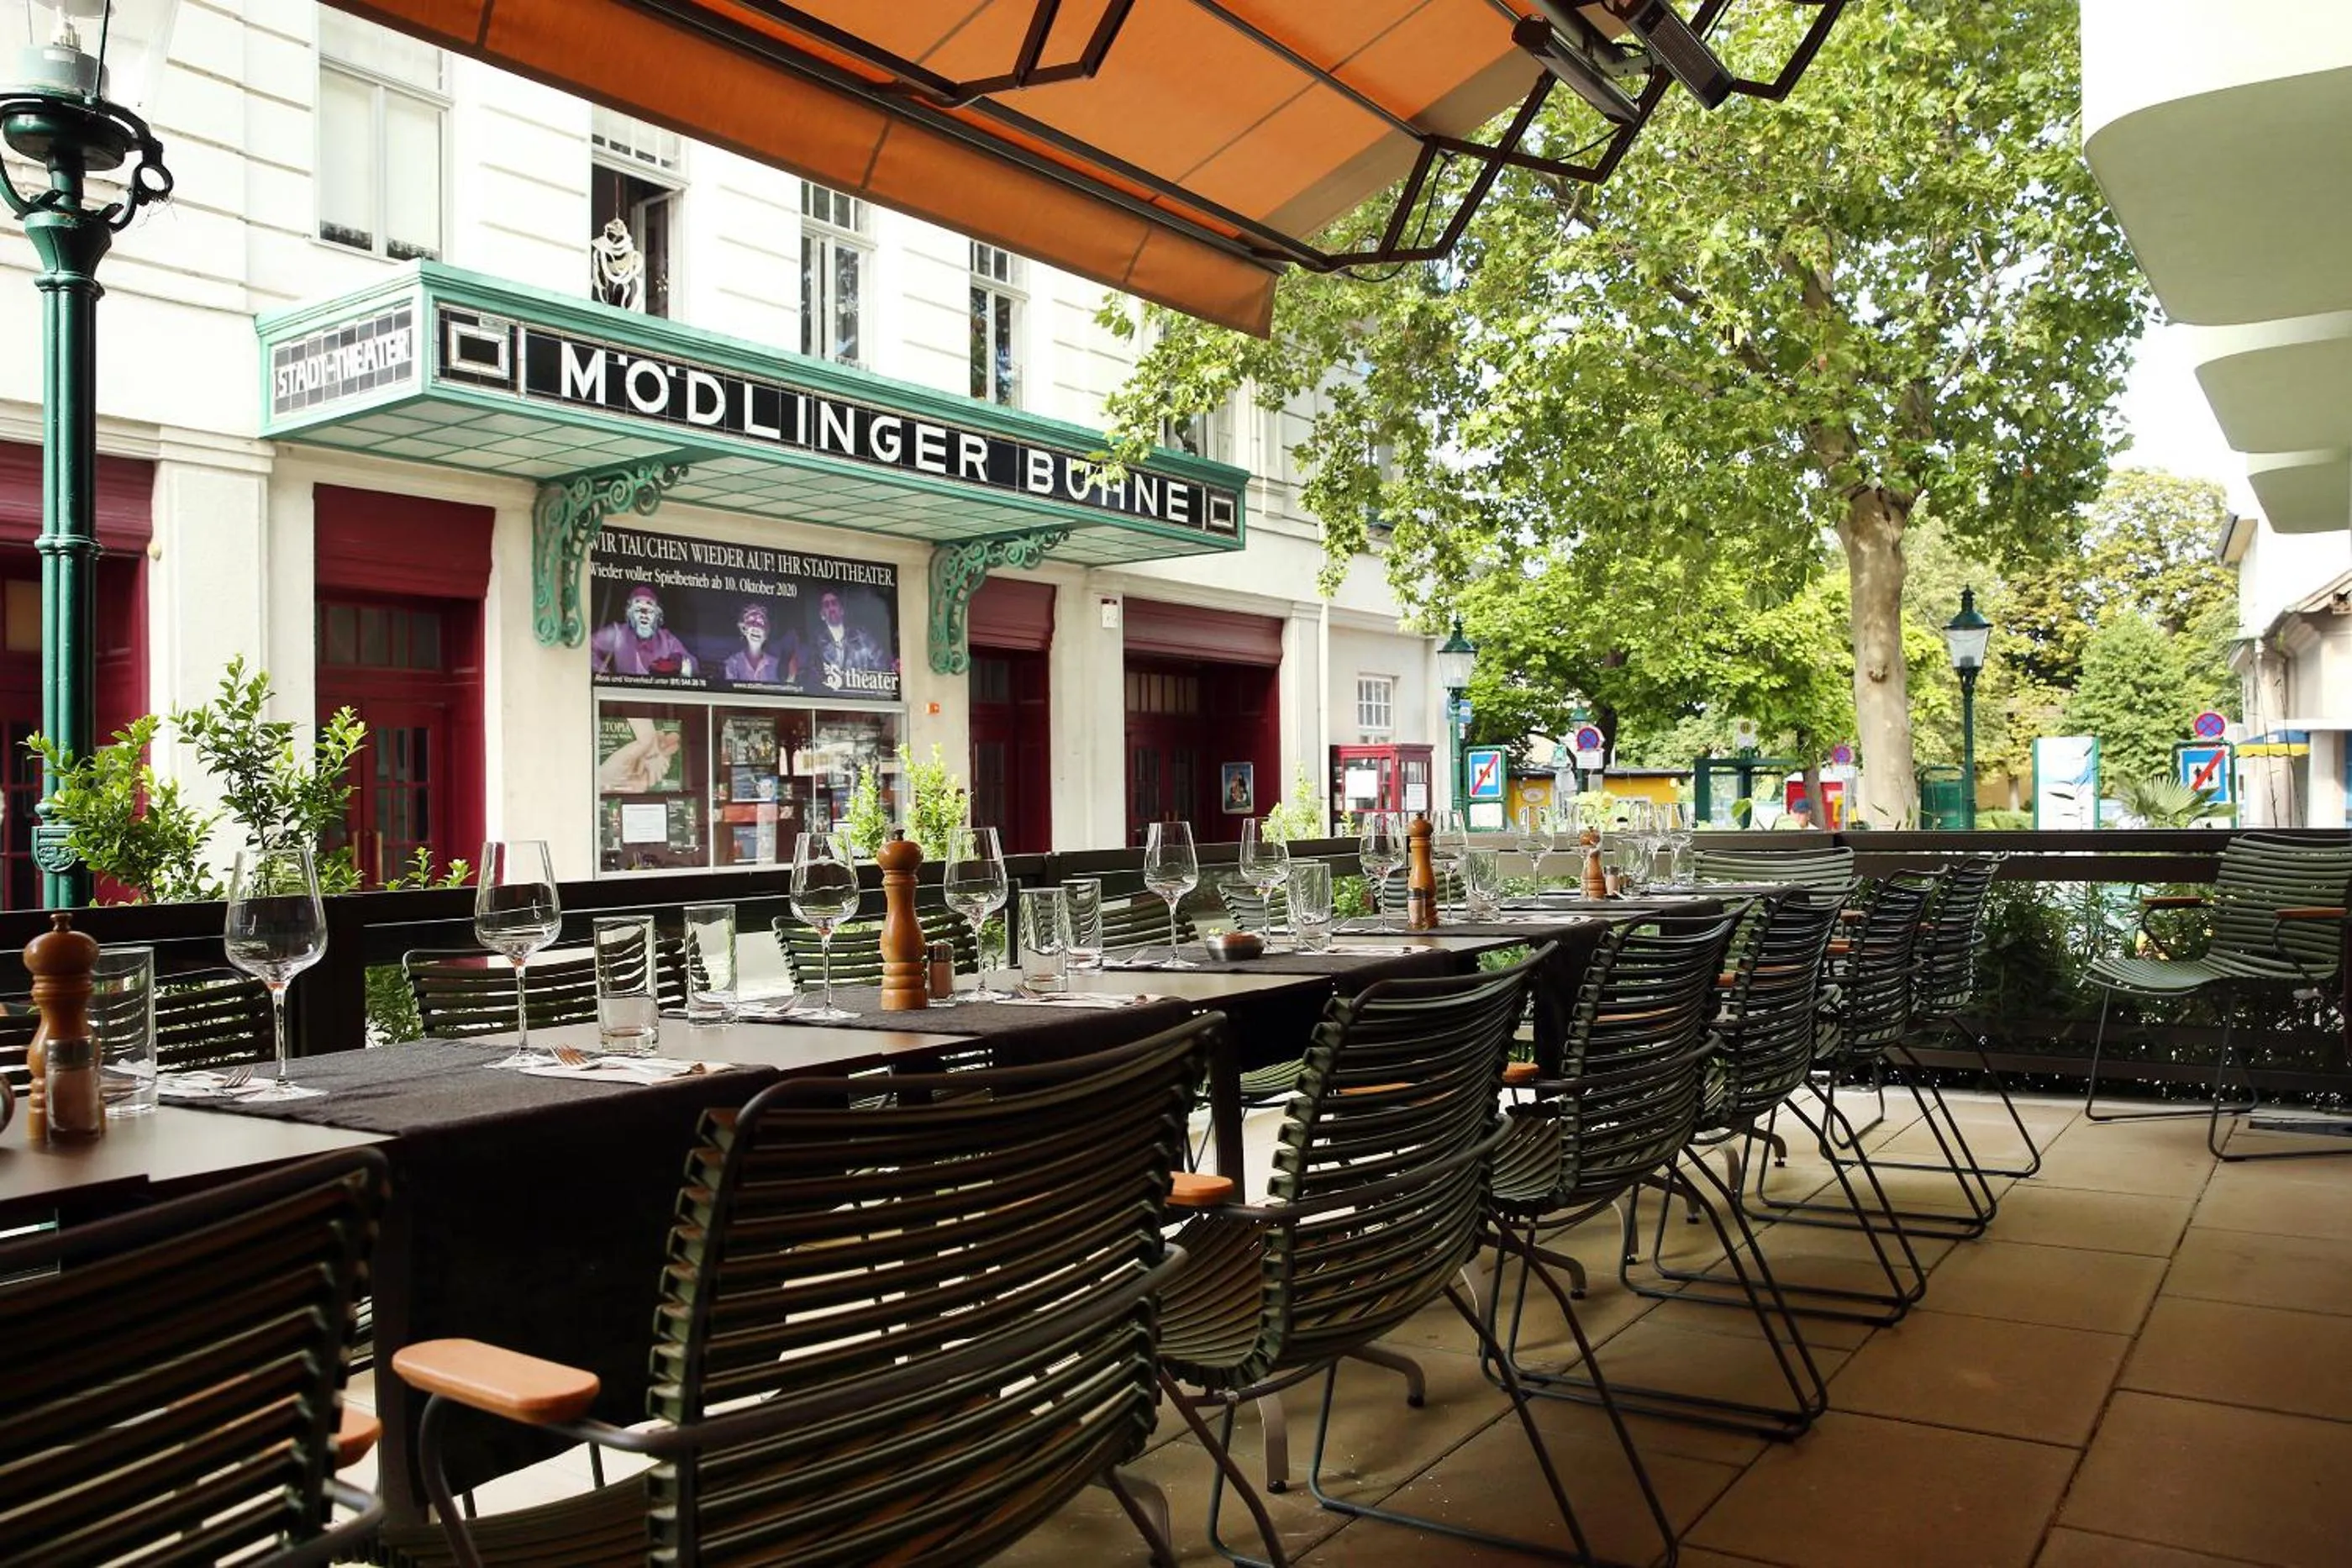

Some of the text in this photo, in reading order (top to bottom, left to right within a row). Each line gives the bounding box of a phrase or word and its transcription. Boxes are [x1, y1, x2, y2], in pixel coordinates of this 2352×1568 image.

[276, 329, 411, 397] STADT-THEATER
[560, 340, 990, 482] MÖDLINGER
[619, 534, 688, 561] TAUCHEN
[691, 544, 745, 569] WIEDER
[746, 550, 775, 572] AUF!
[778, 554, 801, 575] IHR
[590, 562, 797, 598] Wieder voller Spielbetrieb ab 10. Oktober 2020
[845, 667, 898, 690] theater
